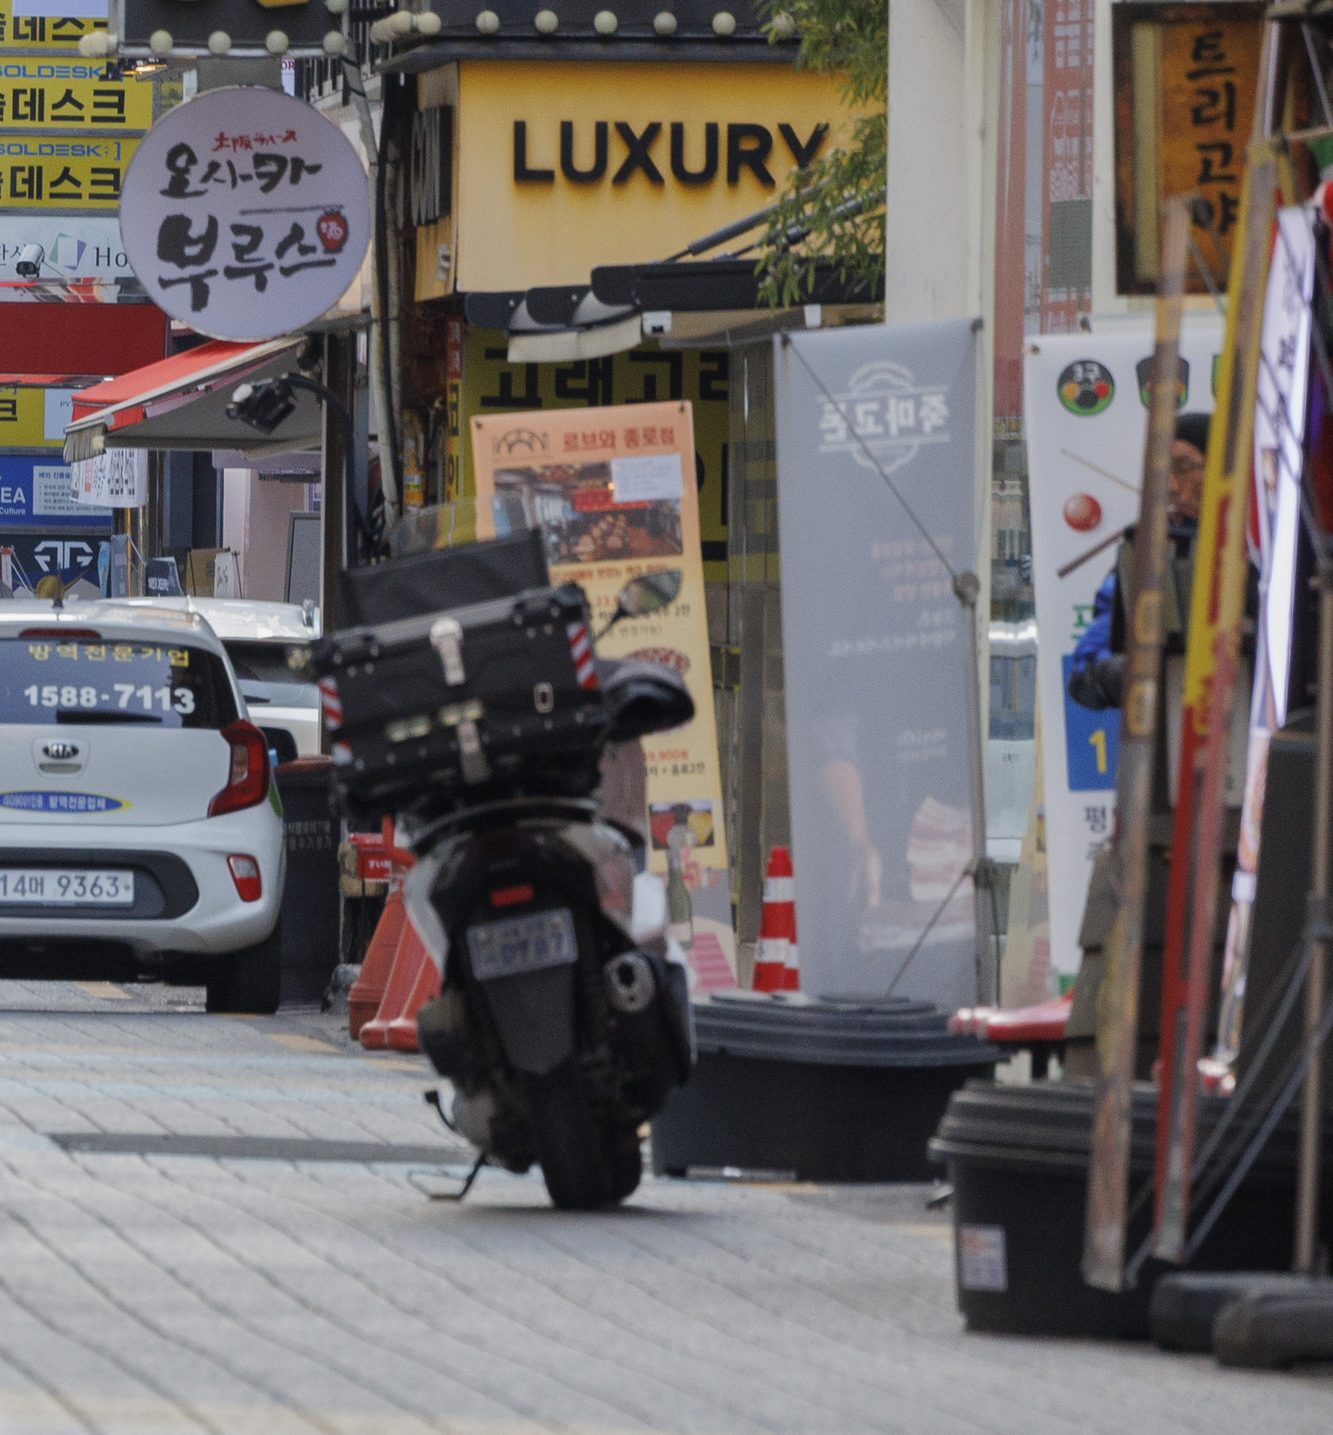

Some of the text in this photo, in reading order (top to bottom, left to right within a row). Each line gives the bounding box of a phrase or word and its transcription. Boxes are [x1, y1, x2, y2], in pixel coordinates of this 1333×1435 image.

[513, 119, 831, 188] LUXURY
[24, 683, 196, 715] 1588-7113
[47, 743, 76, 759] KIA
[57, 872, 120, 899] 9363
